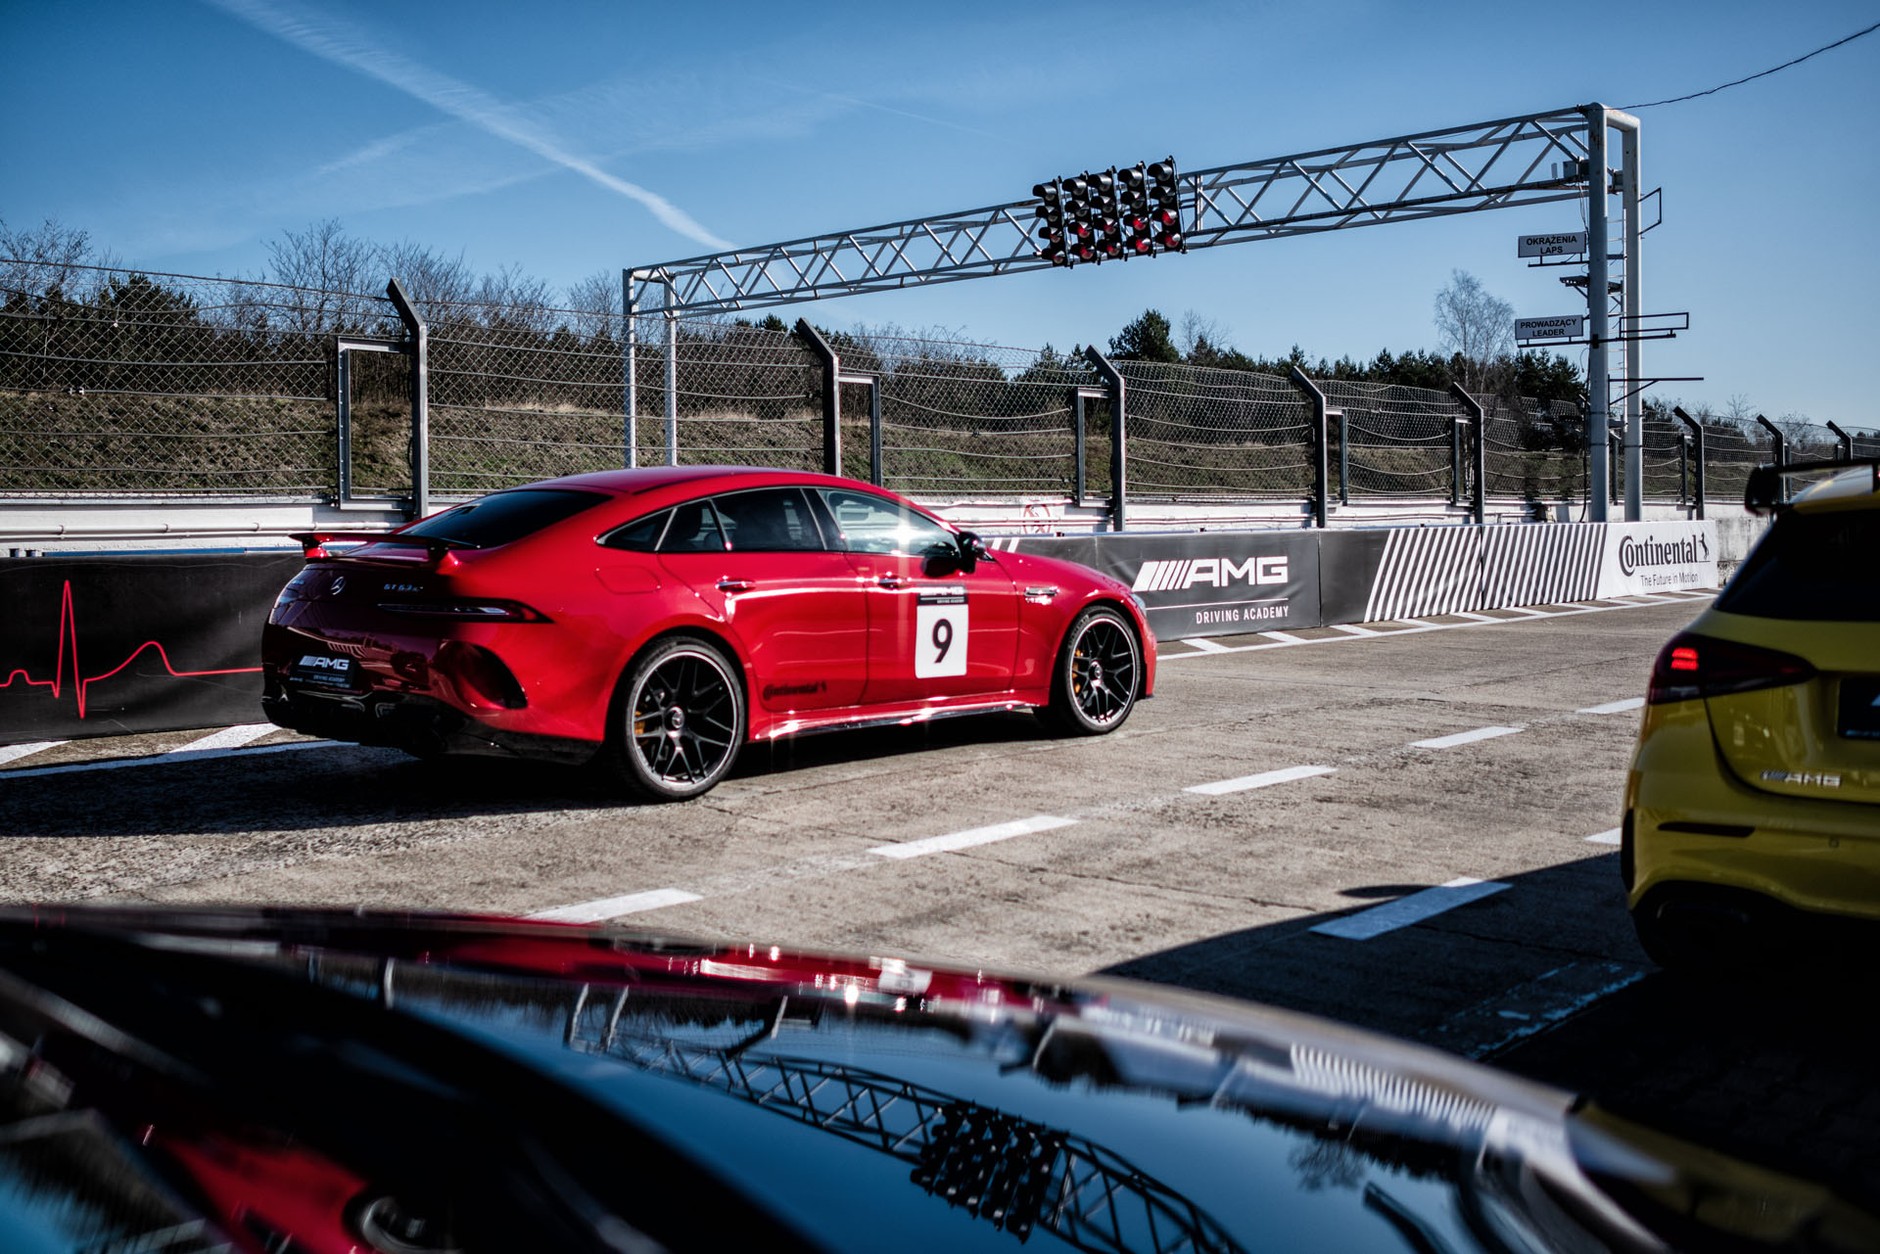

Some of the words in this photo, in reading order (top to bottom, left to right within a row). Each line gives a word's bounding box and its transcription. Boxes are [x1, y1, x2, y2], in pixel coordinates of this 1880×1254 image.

[1526, 235, 1577, 246] OKRĄŻENIA
[1540, 246, 1563, 254] LAPS
[1520, 319, 1577, 329] PROWADZĄCY
[1532, 328, 1565, 337] LEADER
[1618, 534, 1698, 577] Continental
[1181, 556, 1288, 590] AMG
[1640, 574, 1652, 587] The
[1195, 608, 1240, 625] DRIVING
[1243, 605, 1289, 621] ACADEMY
[932, 618, 954, 664] 9
[313, 657, 351, 671] AMG
[1784, 771, 1841, 788] AMG
